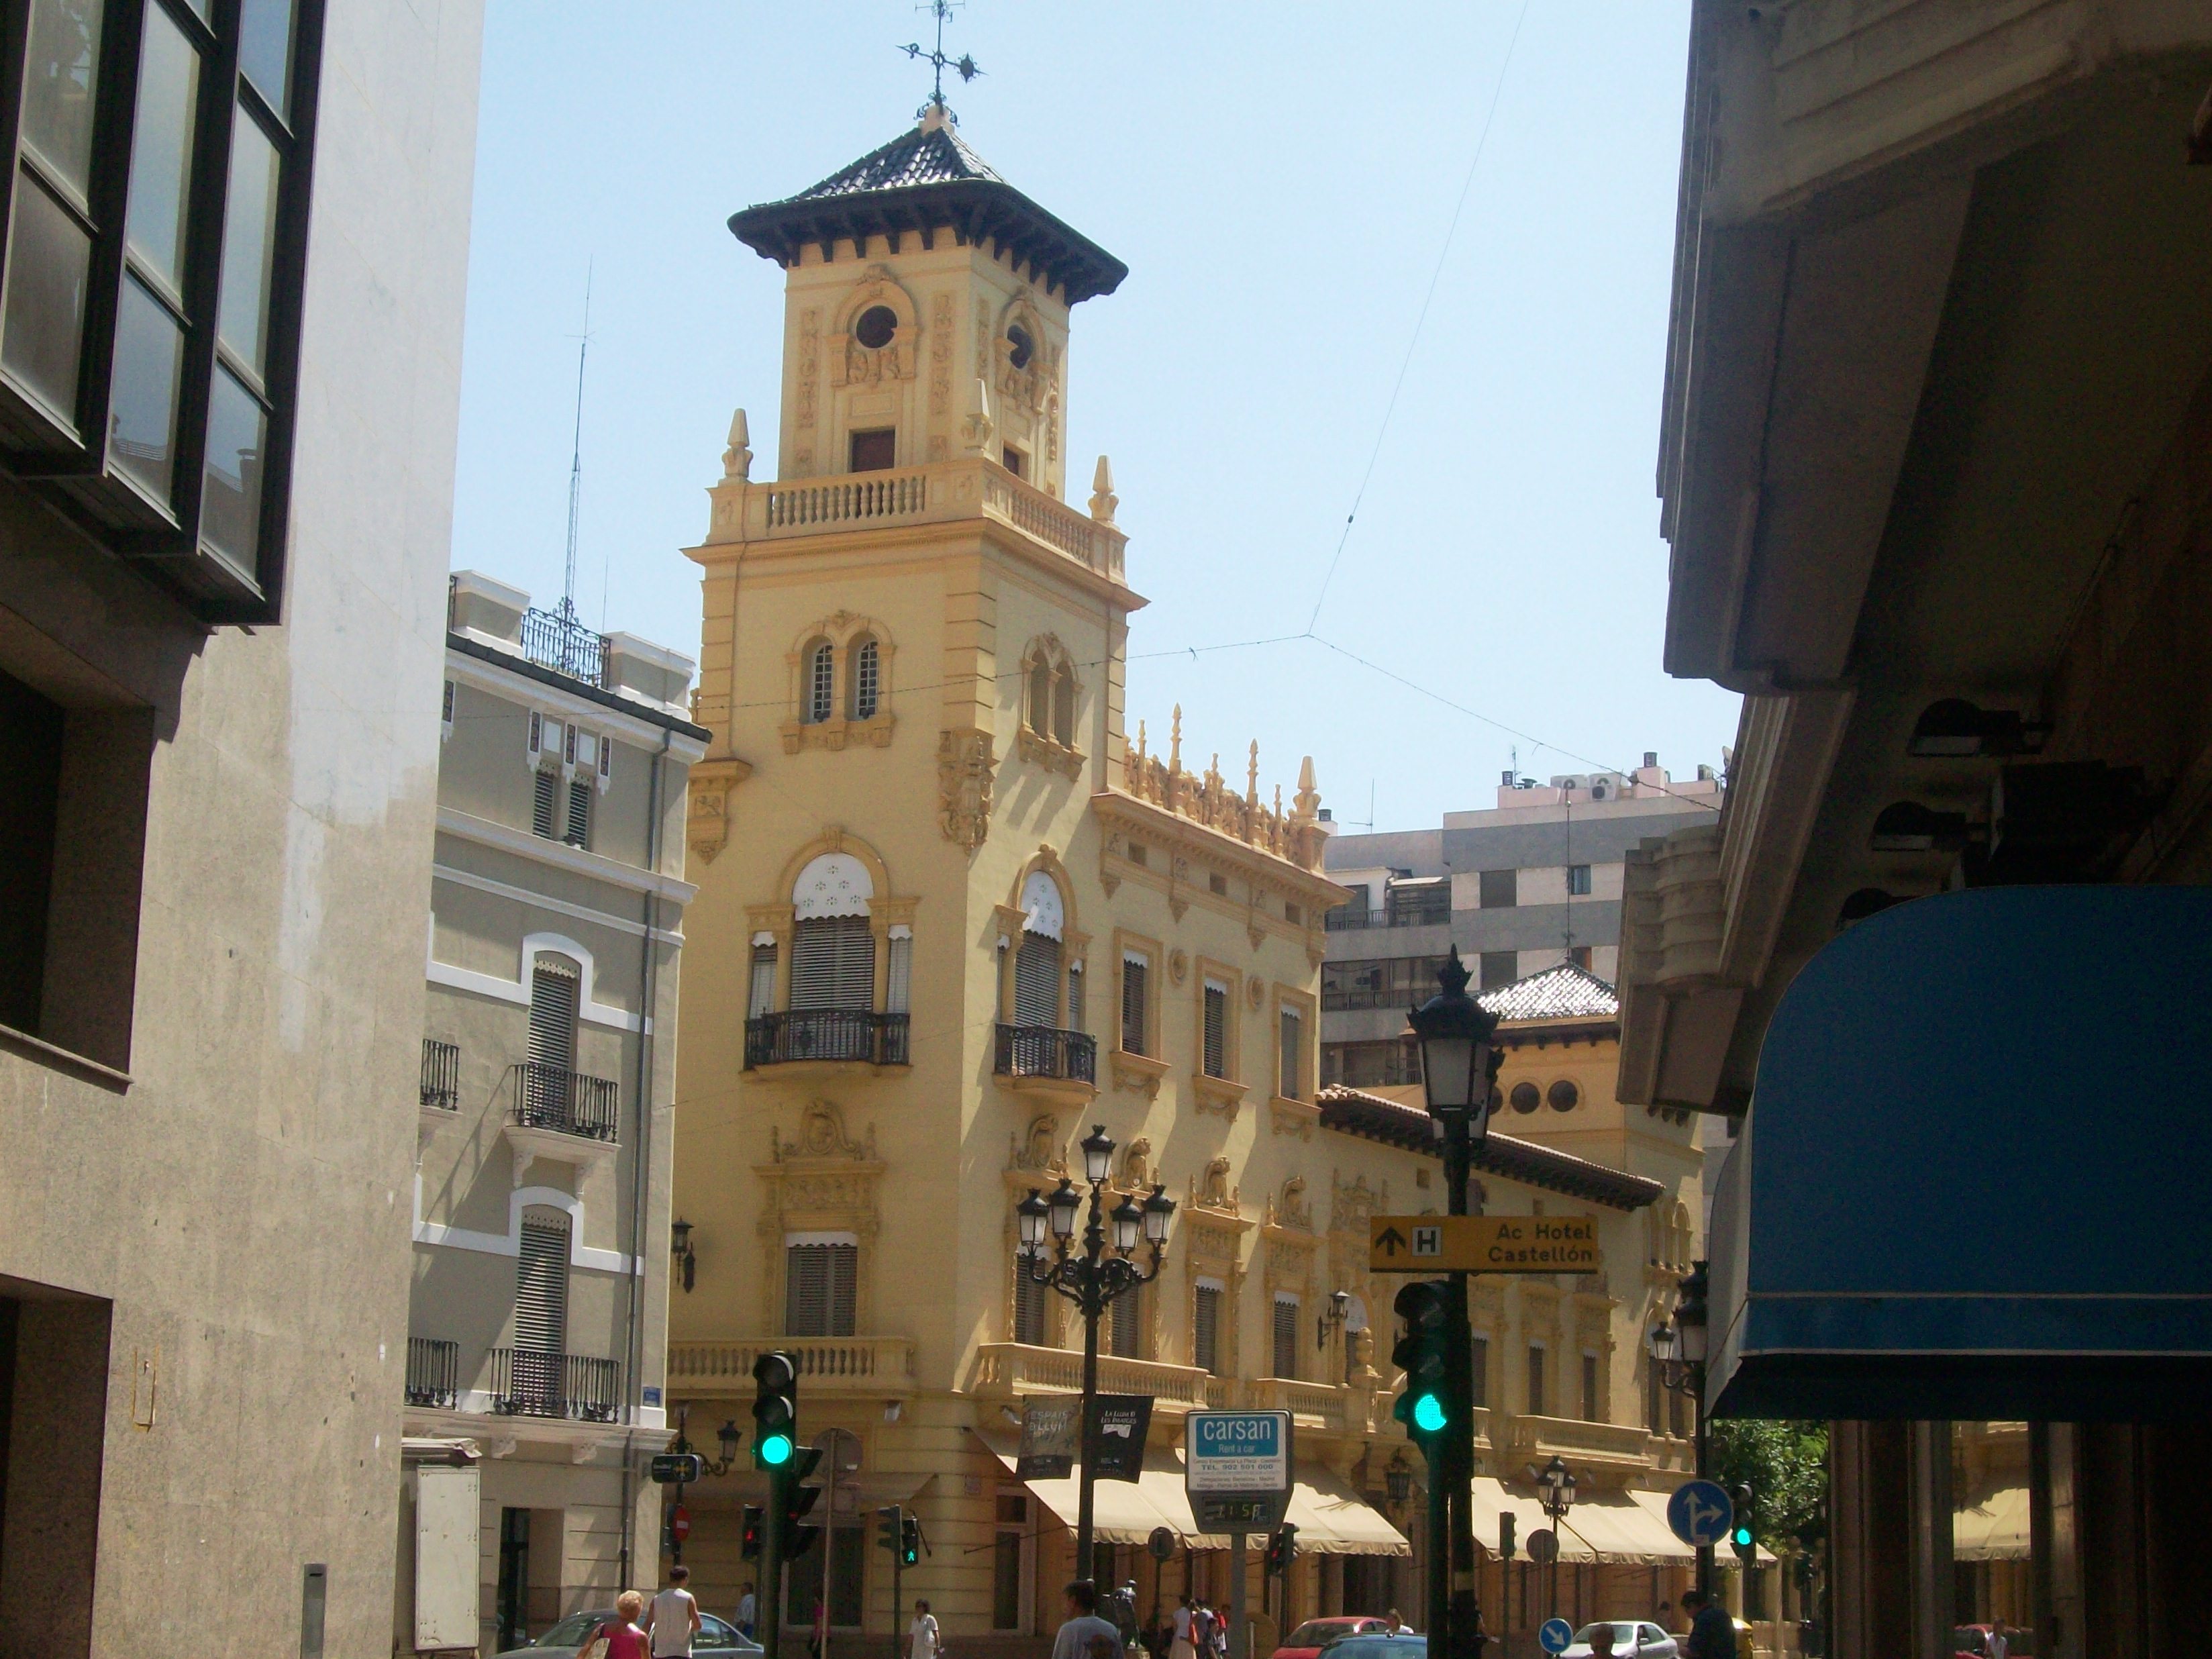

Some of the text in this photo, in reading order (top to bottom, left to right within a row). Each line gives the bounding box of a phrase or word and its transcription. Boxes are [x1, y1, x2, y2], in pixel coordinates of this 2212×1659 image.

[1497, 1223, 1593, 1240] Ac Hotel
[1417, 1229, 1436, 1253] H
[1488, 1246, 1593, 1263] Castellón
[1203, 1419, 1271, 1441] carsan
[1219, 1444, 1236, 1453] Rent
